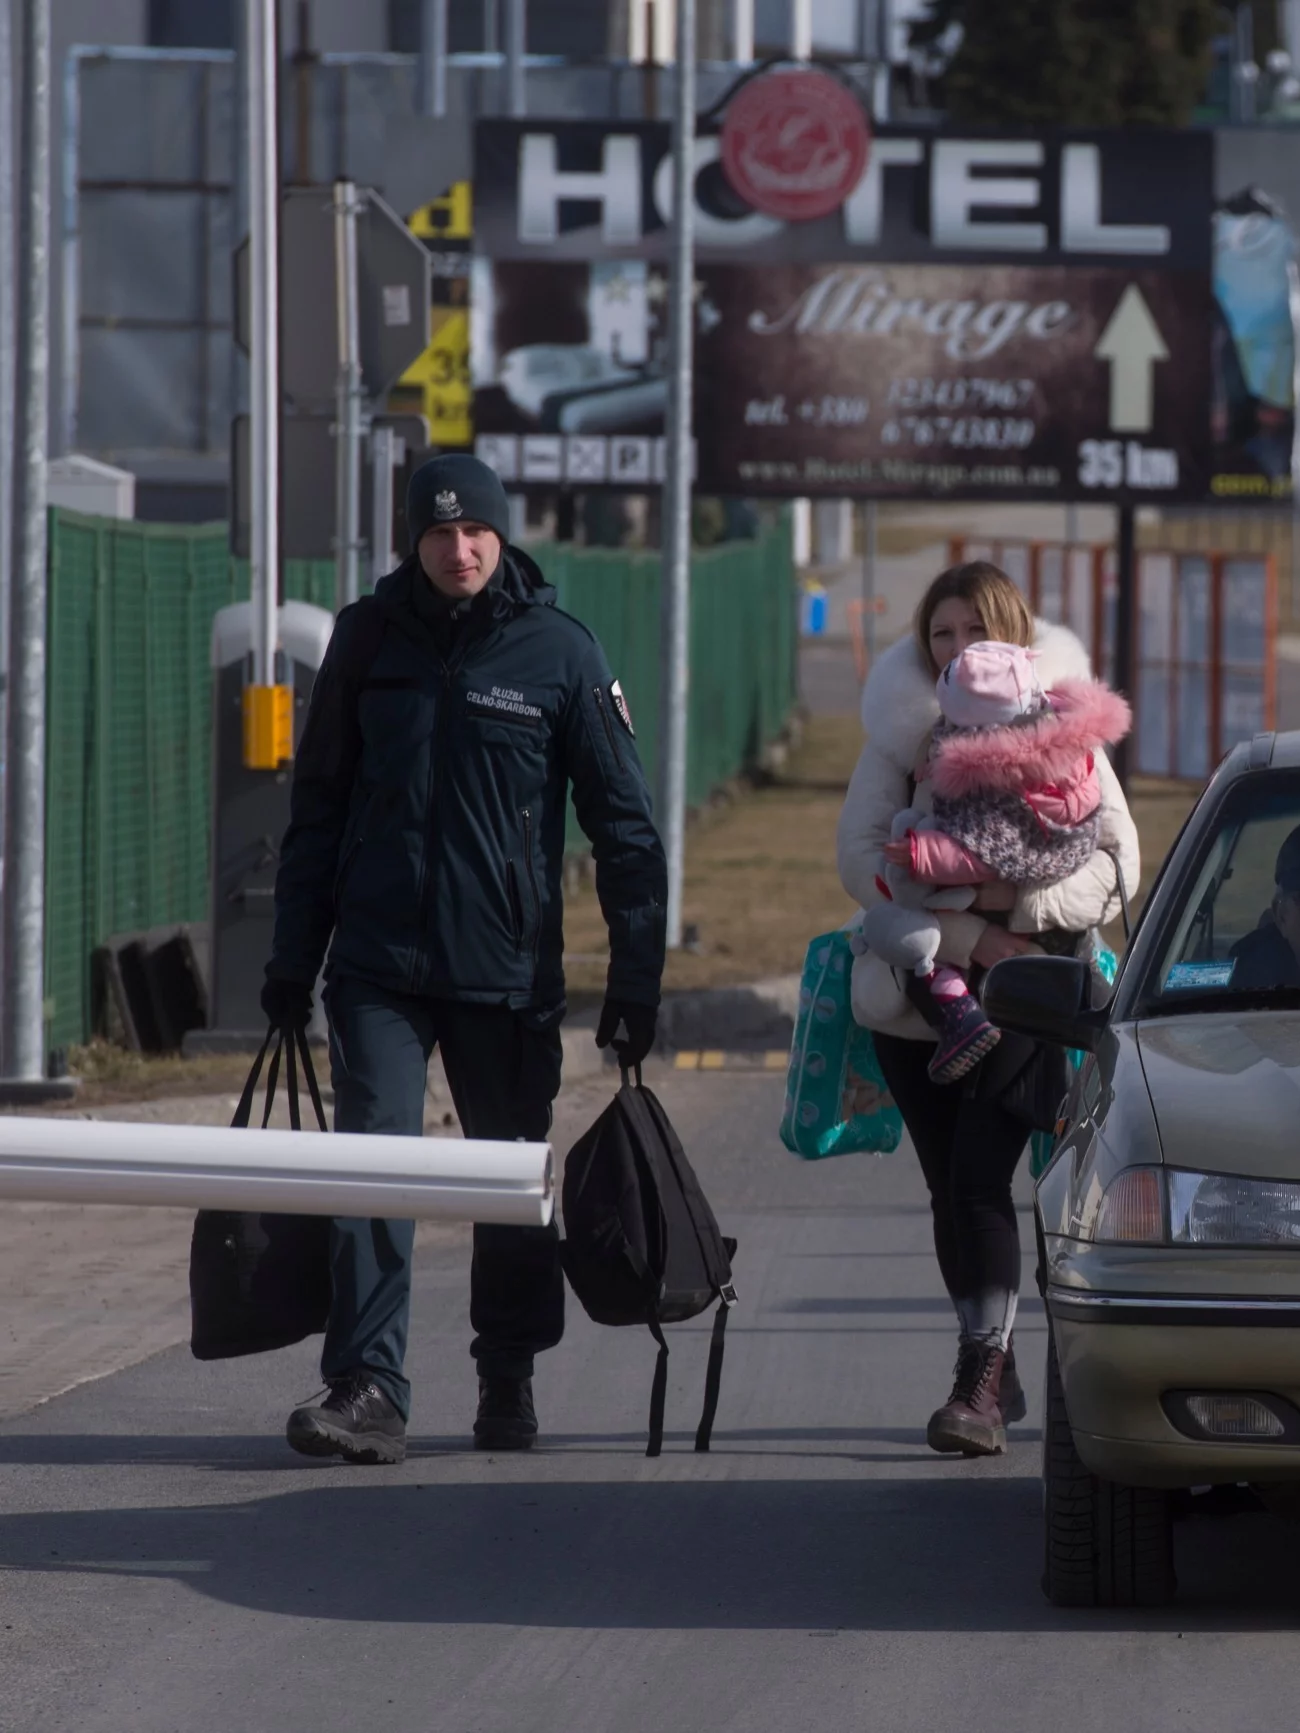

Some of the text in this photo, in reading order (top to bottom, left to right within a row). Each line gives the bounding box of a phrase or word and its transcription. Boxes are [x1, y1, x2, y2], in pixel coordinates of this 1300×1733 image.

[517, 131, 1171, 256] HOTEL
[747, 270, 1075, 363] Mirage
[1078, 438, 1179, 490] 35 km
[466, 690, 542, 717] CELNO-SKARBOWA
[491, 686, 524, 703] SŁUŻBA
